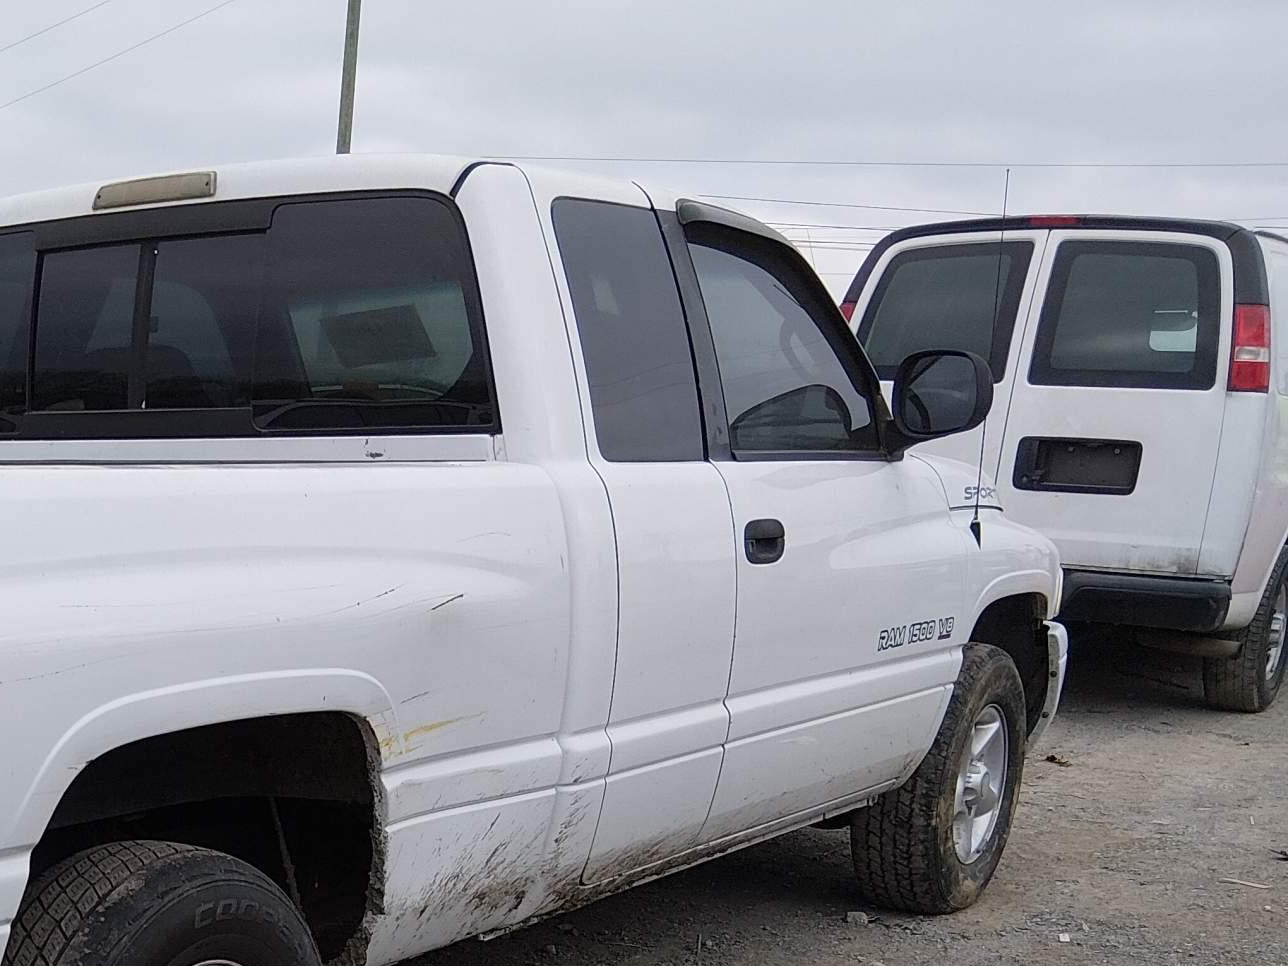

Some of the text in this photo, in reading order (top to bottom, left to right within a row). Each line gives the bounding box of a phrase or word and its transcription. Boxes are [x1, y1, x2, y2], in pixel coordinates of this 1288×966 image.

[877, 616, 955, 651] RAM 1500 V8
